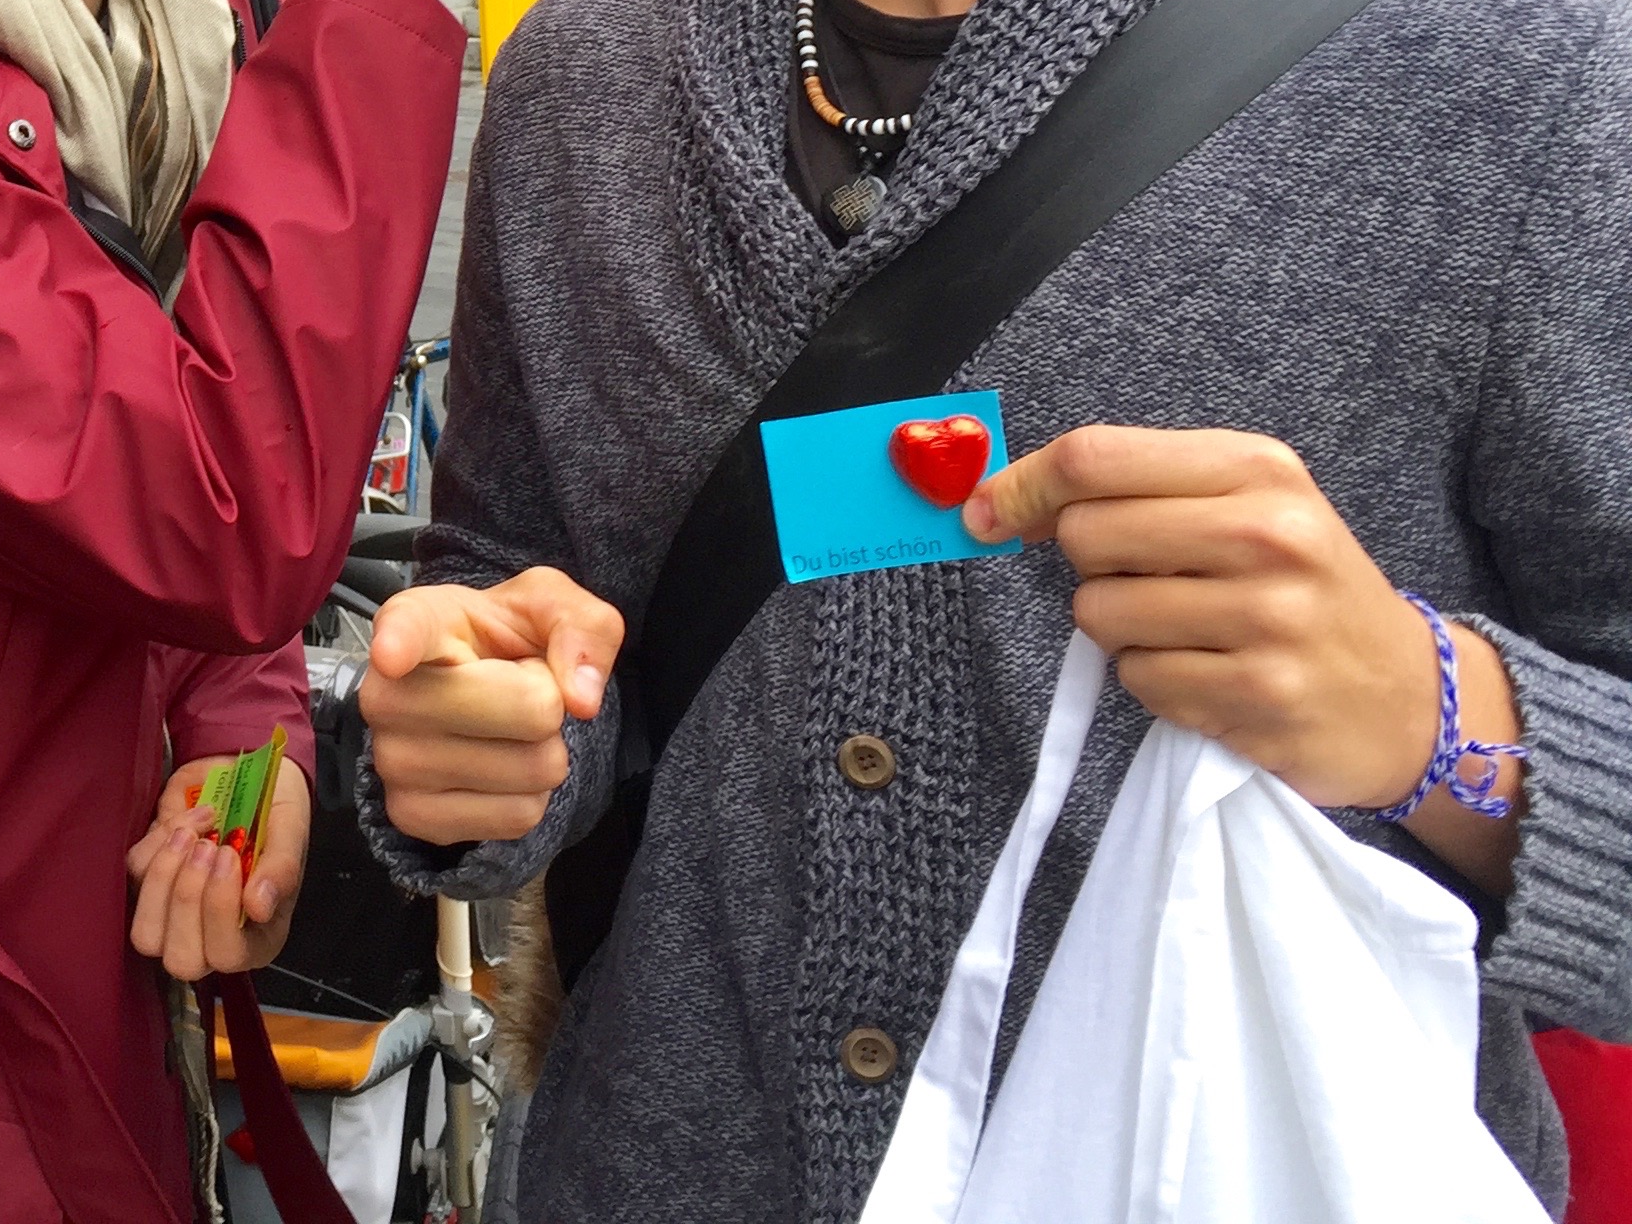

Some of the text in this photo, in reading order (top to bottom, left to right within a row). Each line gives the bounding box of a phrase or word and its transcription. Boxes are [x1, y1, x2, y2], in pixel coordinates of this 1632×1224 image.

[792, 536, 943, 574] Du bist schön
[211, 771, 229, 804] tolle
